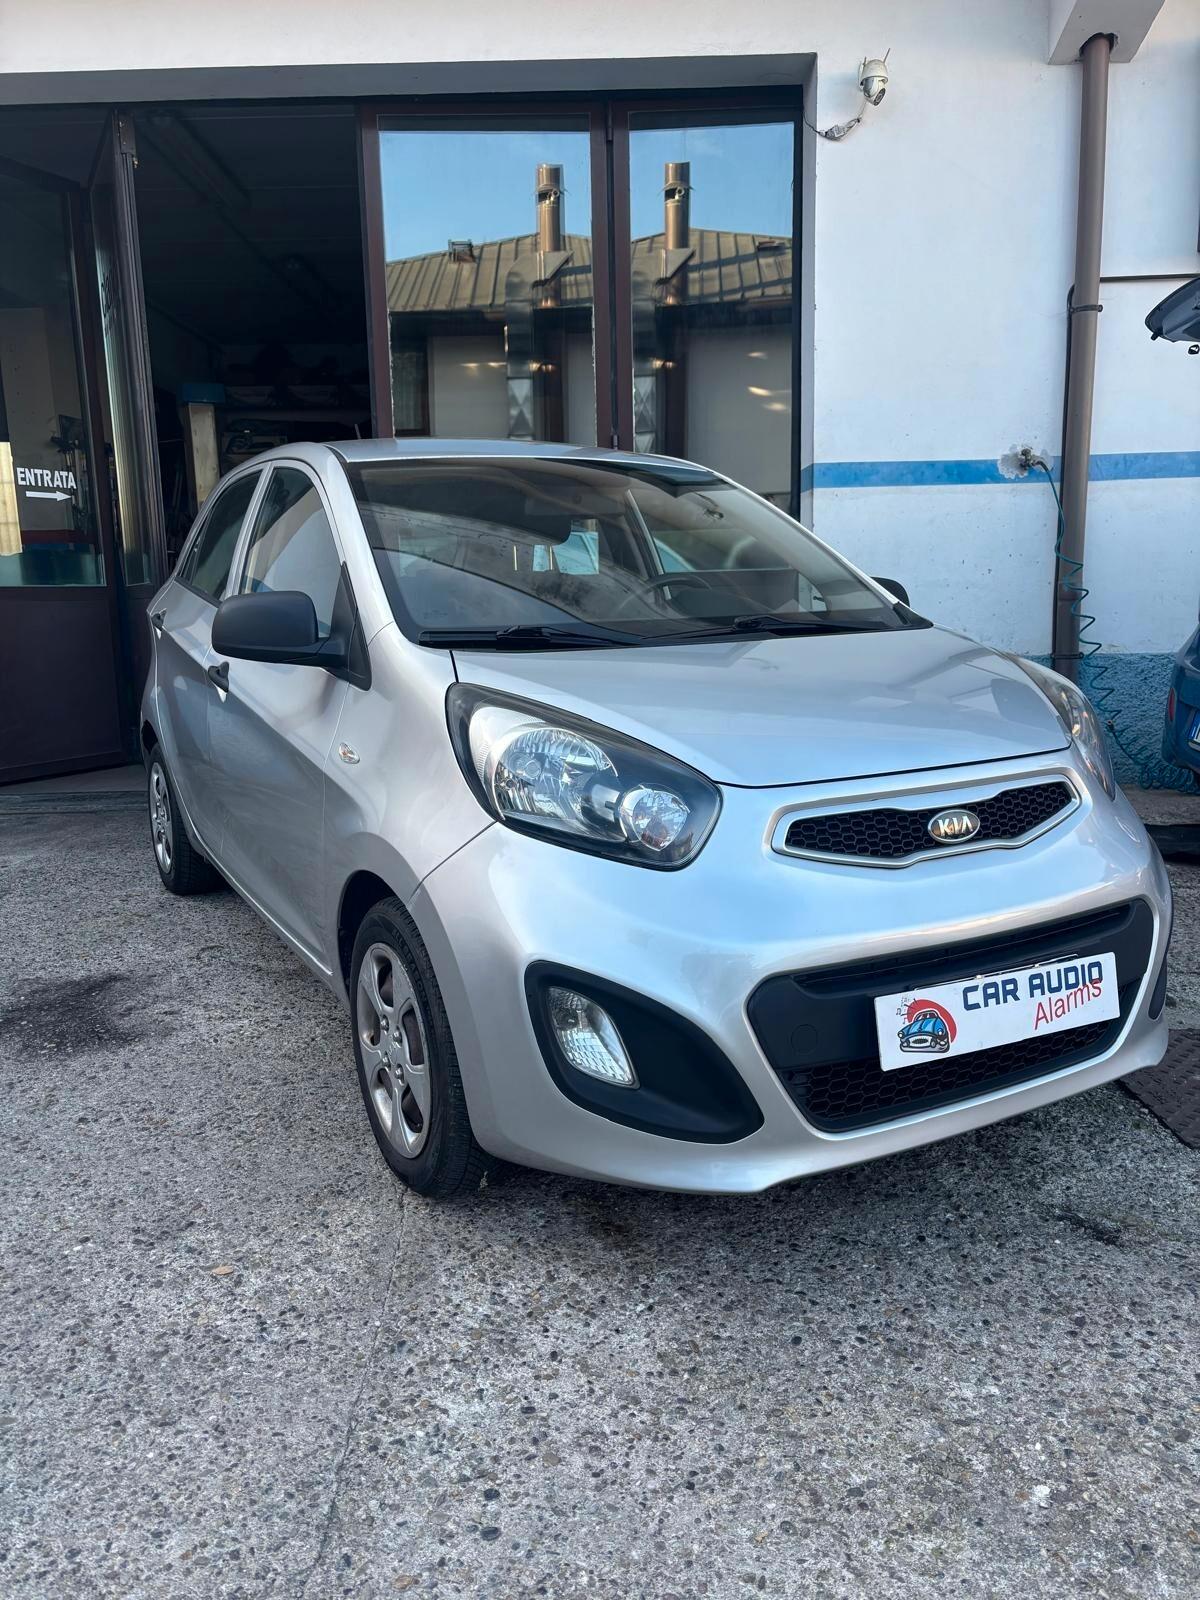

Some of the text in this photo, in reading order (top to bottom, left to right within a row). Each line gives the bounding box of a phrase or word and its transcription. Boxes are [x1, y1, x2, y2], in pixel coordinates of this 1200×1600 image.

[16, 467, 77, 489] ENTRATA
[937, 815, 974, 837] KIA
[962, 961, 1103, 1011] CAR AUDIO
[1034, 978, 1102, 1030] Alarms
